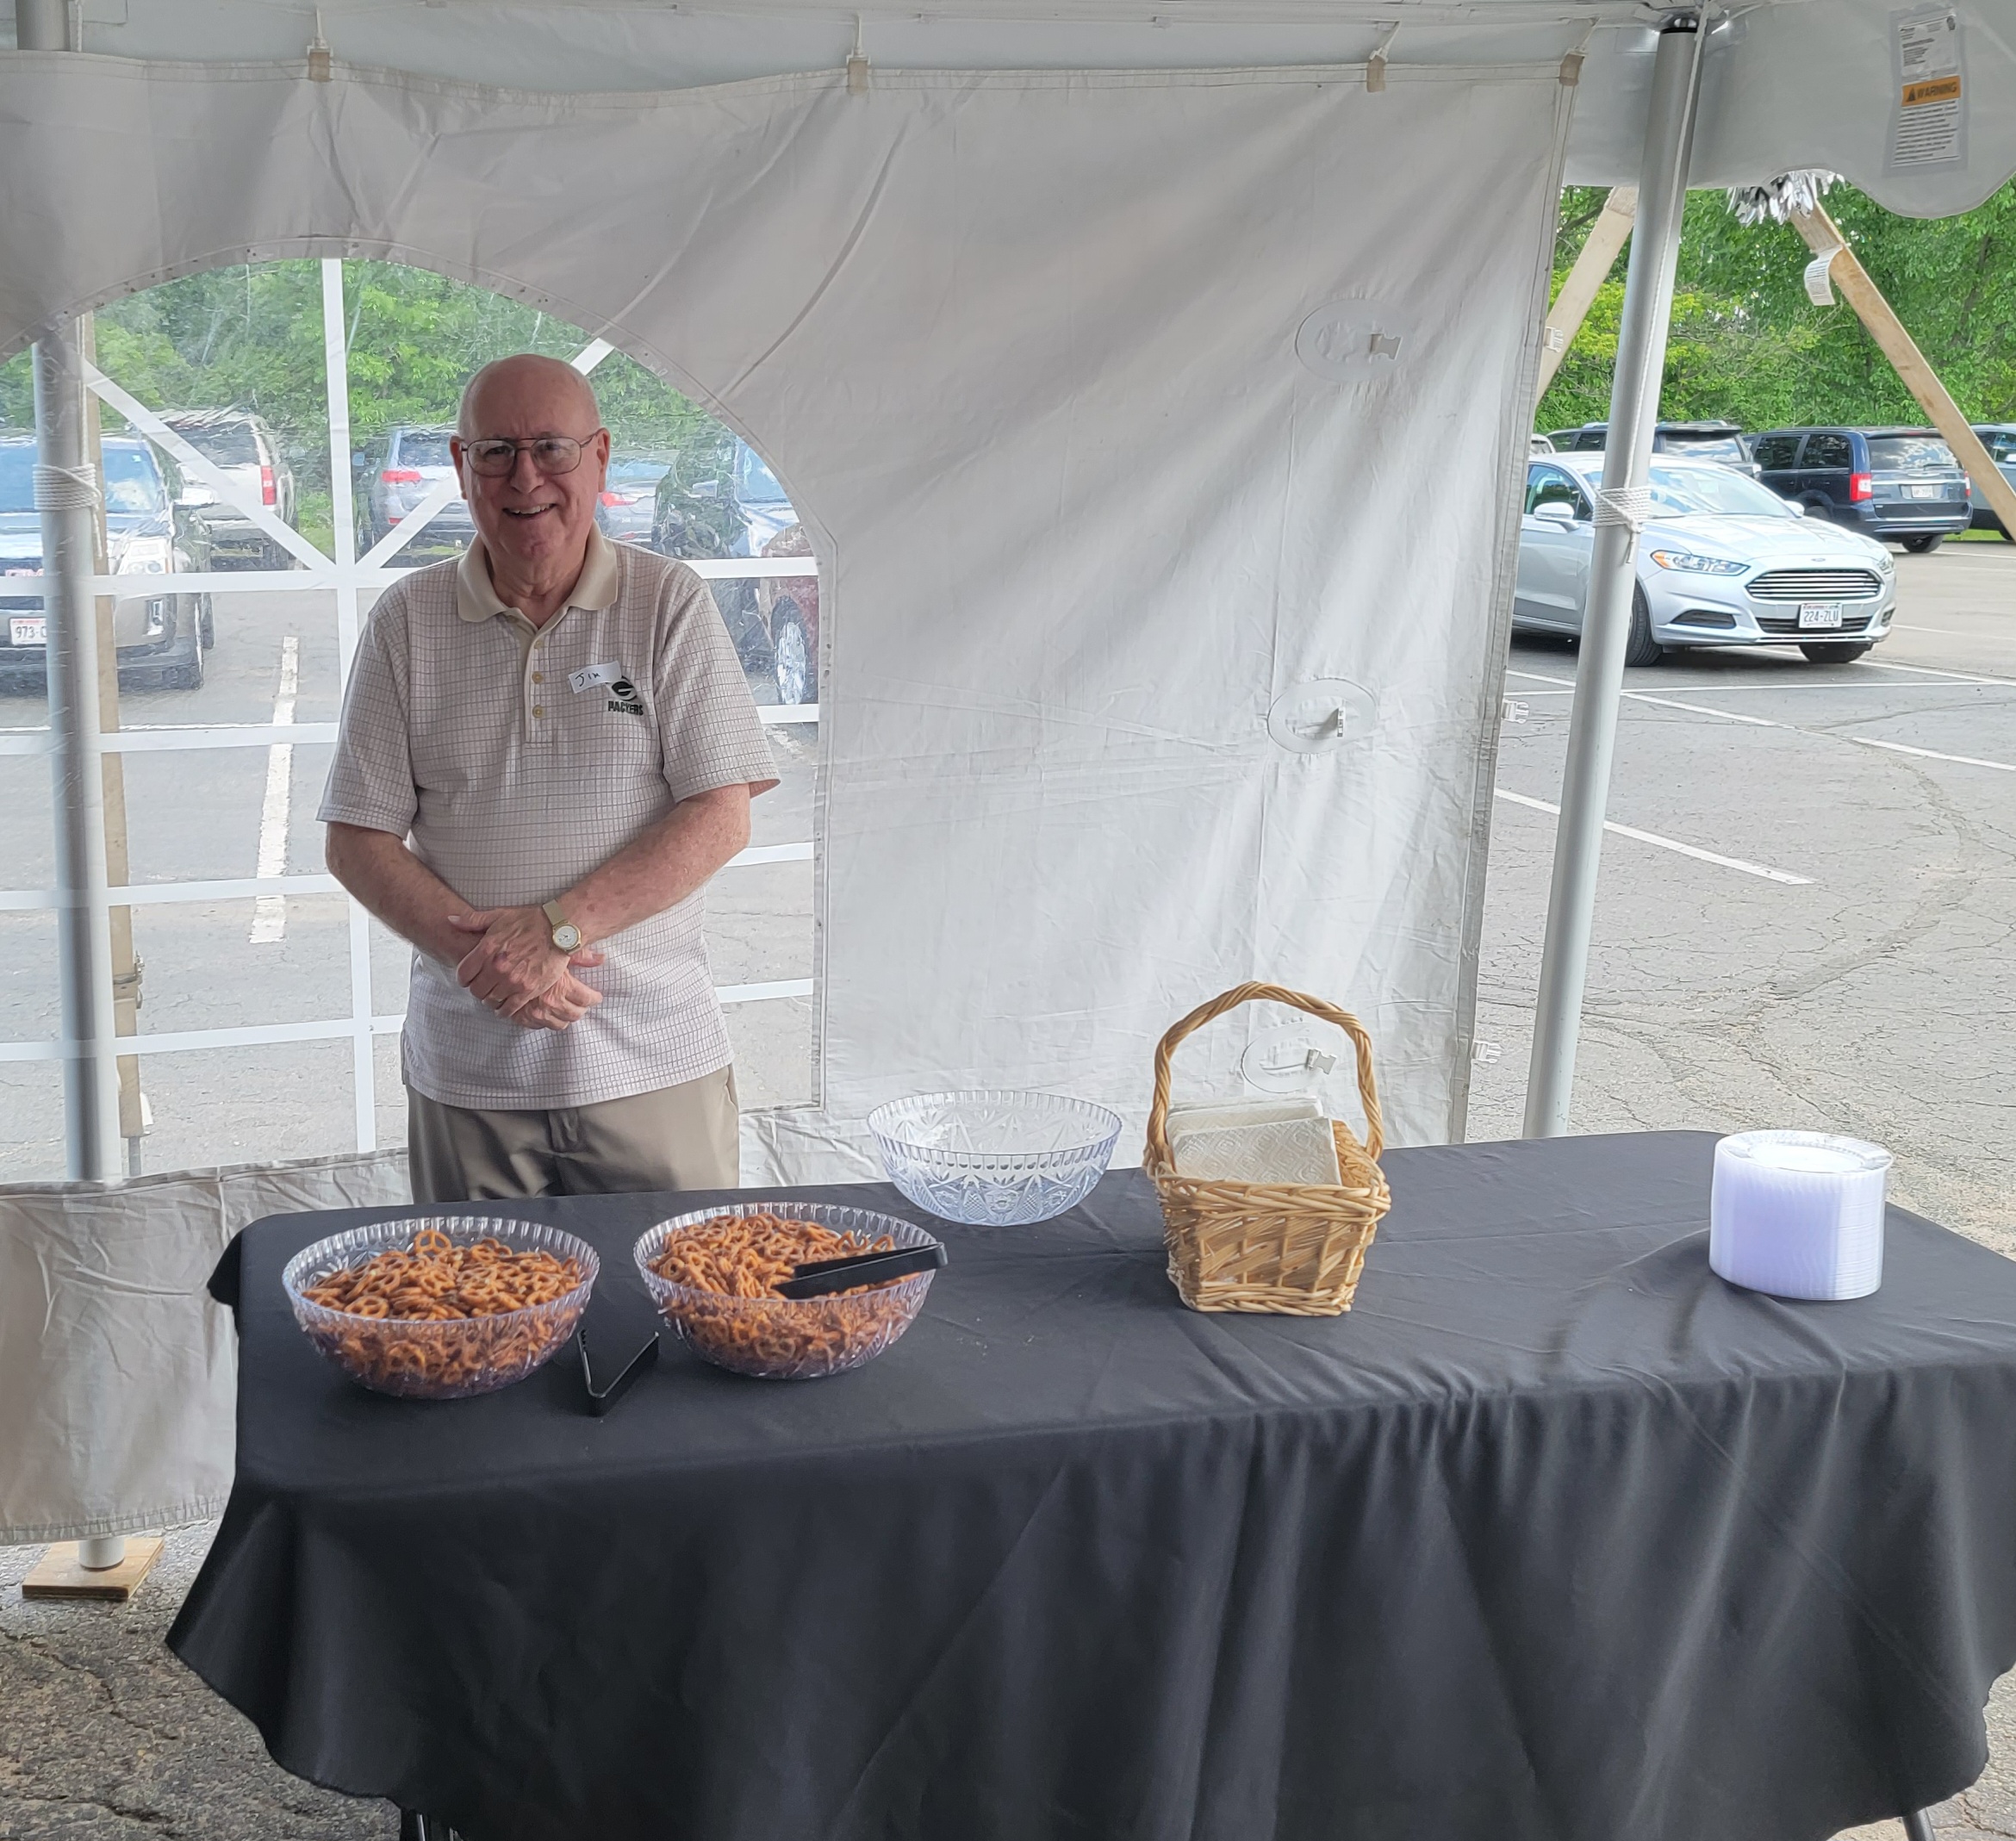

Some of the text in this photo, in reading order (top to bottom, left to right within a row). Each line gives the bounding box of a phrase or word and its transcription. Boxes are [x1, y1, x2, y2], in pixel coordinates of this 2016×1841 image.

[1917, 82, 1957, 98] WARNING
[1804, 611, 1839, 622] 224-ZLU
[607, 700, 644, 716] PACKERS
